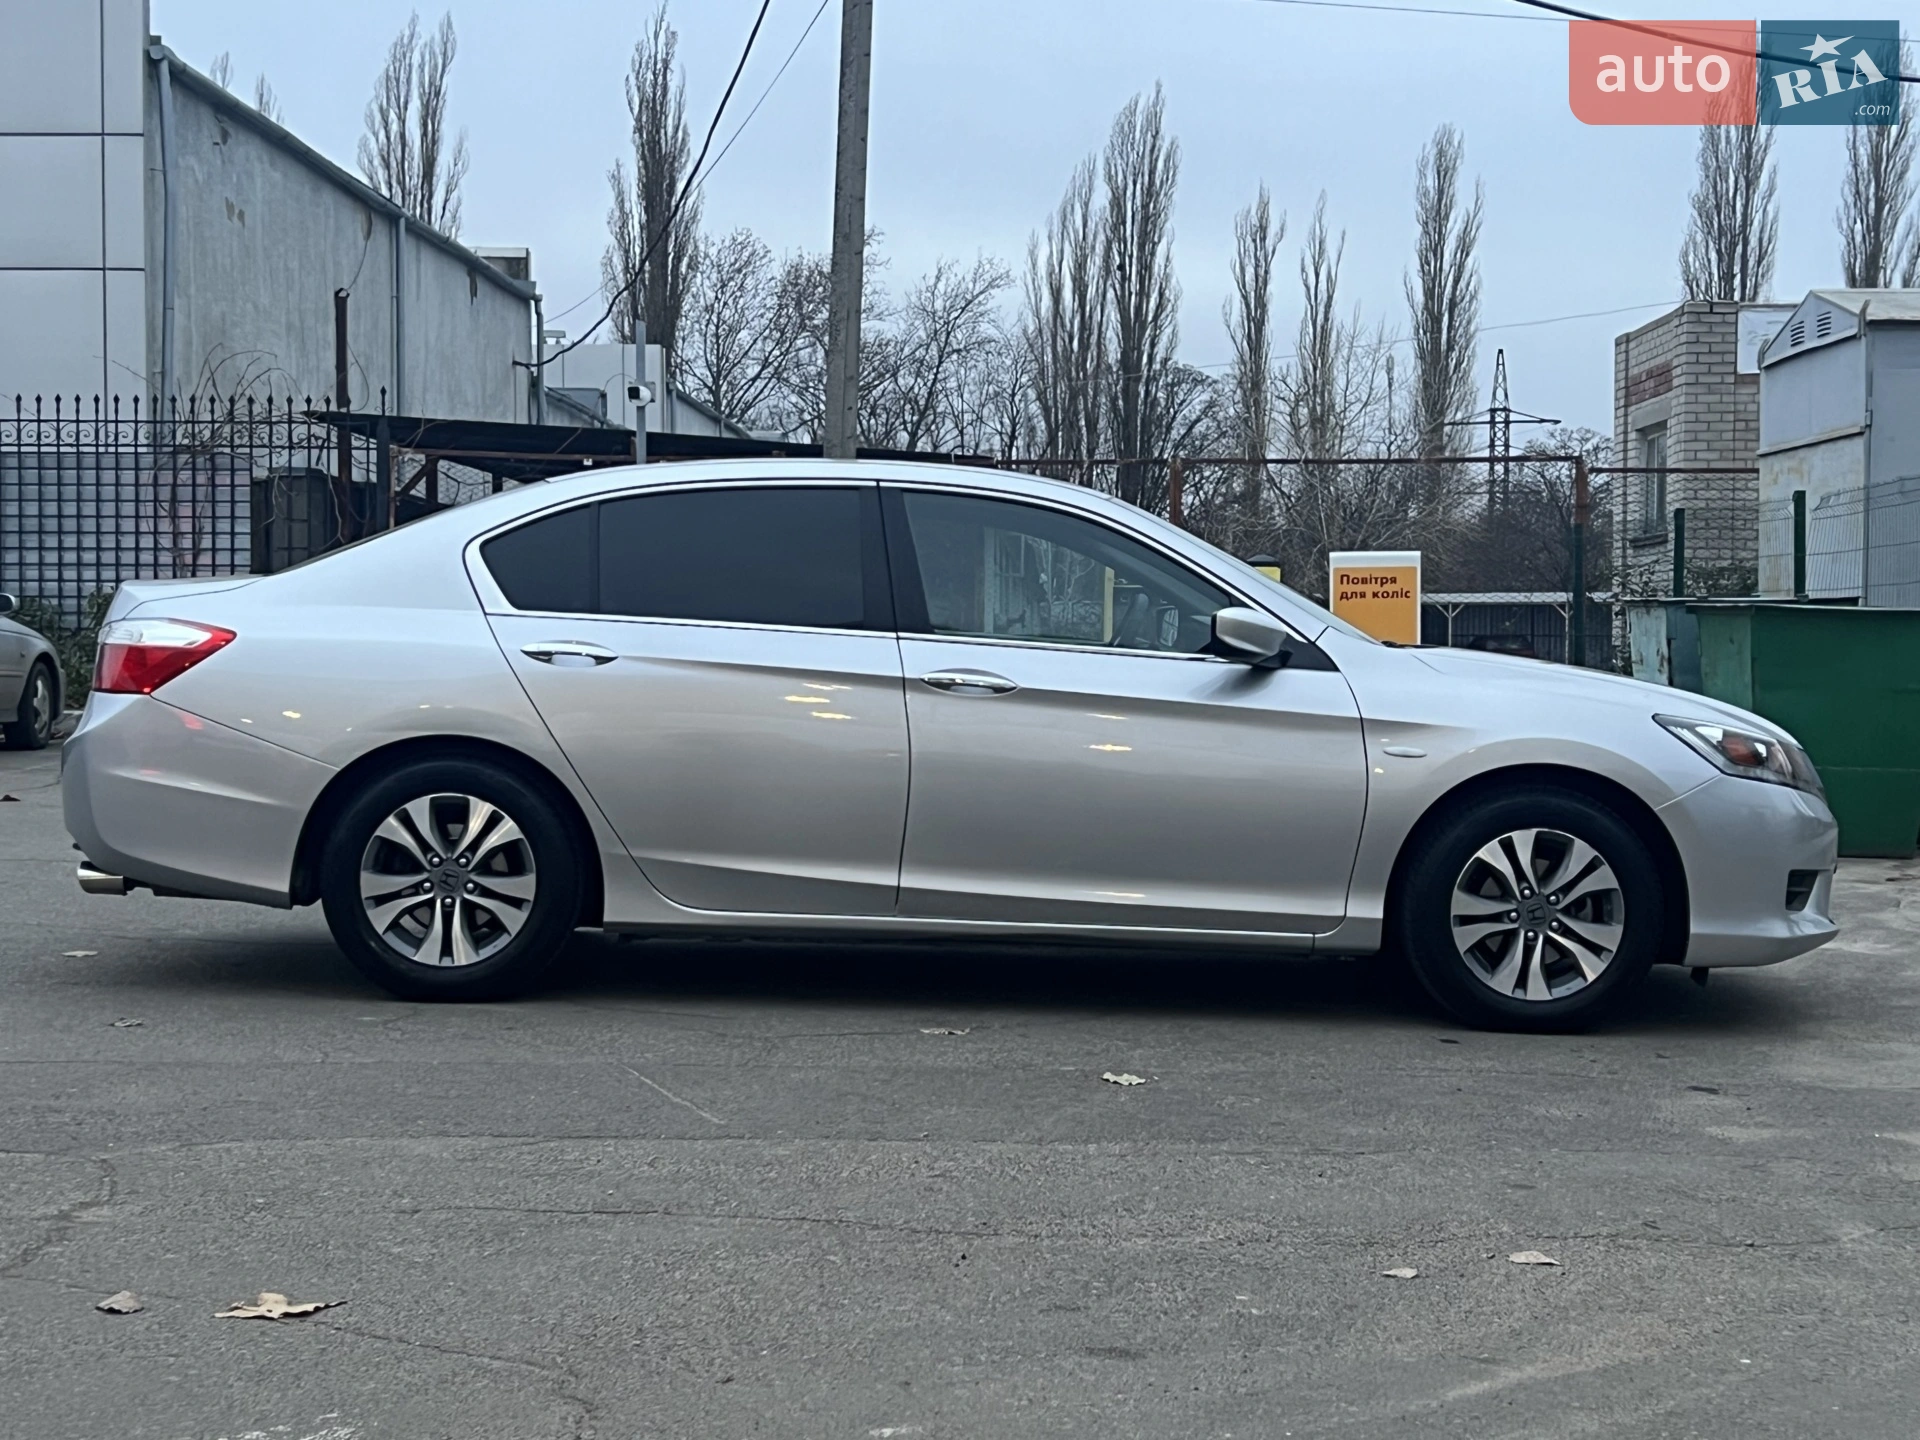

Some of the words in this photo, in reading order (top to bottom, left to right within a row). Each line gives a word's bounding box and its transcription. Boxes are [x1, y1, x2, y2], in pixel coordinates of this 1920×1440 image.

[1340, 573, 1397, 587] Повітря
[1339, 591, 1366, 601] для
[1372, 587, 1411, 599] коліс
